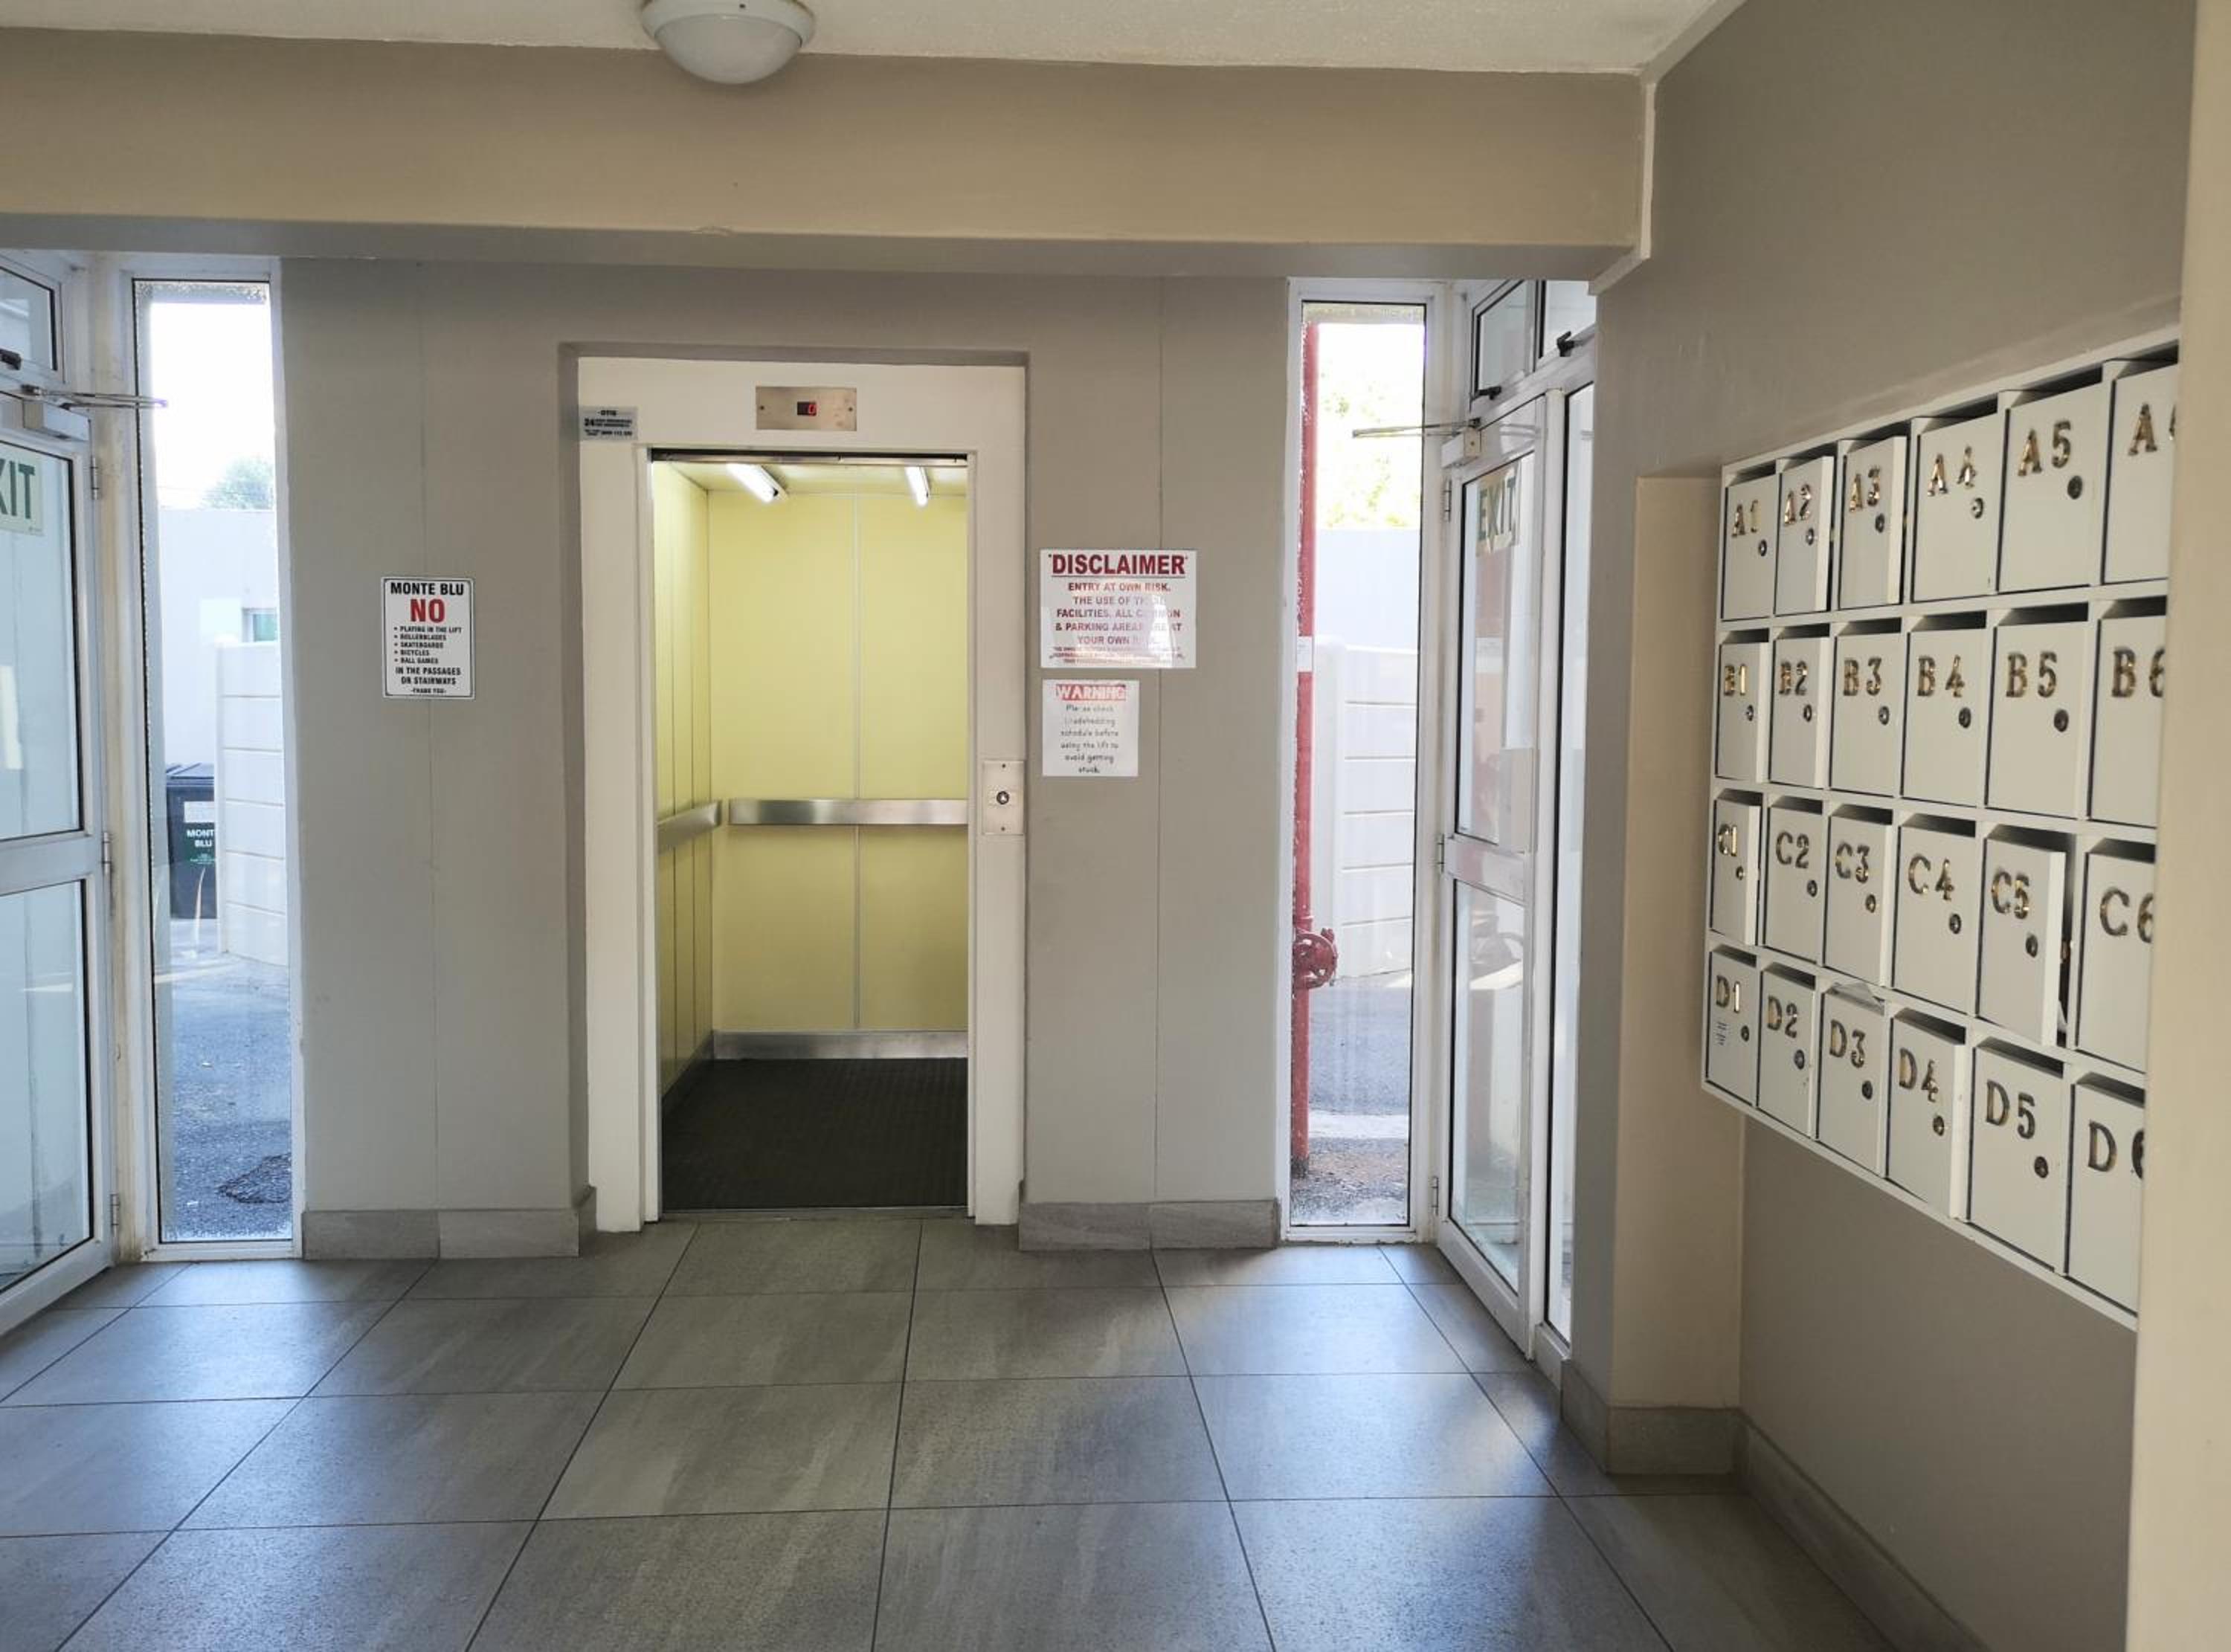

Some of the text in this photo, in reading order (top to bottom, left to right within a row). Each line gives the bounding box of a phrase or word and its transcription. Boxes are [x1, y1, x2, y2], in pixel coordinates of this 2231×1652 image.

[2018, 420, 2071, 476] A5
[2128, 403, 2176, 456] A
[1849, 467, 1881, 512] A3
[1928, 445, 1977, 497] A4
[1478, 476, 1517, 541] EXIT
[1731, 499, 1760, 537] A1
[1784, 484, 1812, 526] A2
[390, 582, 464, 596] MONTE BLU
[1068, 582, 1100, 591] ENTRY
[1103, 583, 1116, 591] AT
[1118, 583, 1142, 591] OWN
[1073, 596, 1093, 604] THE
[1095, 596, 1114, 604] USE
[1118, 596, 1130, 604] OF
[410, 598, 445, 623] NO
[1055, 623, 1063, 631] &
[1066, 623, 1109, 631] PARKING
[1115, 609, 1133, 618] ALL
[1078, 636, 1104, 645] YOUR
[1107, 636, 1130, 645] OWN
[401, 676, 456, 685] OR STAIRWAYS
[422, 667, 461, 675] PASSAGES
[1724, 663, 1745, 697] B1
[1779, 660, 1809, 696] B2
[1843, 656, 1882, 697] B3
[1917, 654, 1965, 697] B4
[2006, 651, 2057, 698] B5
[2111, 646, 2165, 699] B6
[1718, 823, 1737, 856] C1
[1775, 830, 1809, 869] C2
[1835, 841, 1870, 883] C3
[1908, 854, 1954, 901] C4
[1991, 868, 2029, 920] C5
[2099, 886, 2154, 943] C6
[1716, 975, 1739, 1013] D1
[1767, 995, 1797, 1039] D2
[1829, 1019, 1865, 1068] D3
[1899, 1048, 1939, 1103] D4
[1986, 1079, 2035, 1139] D5
